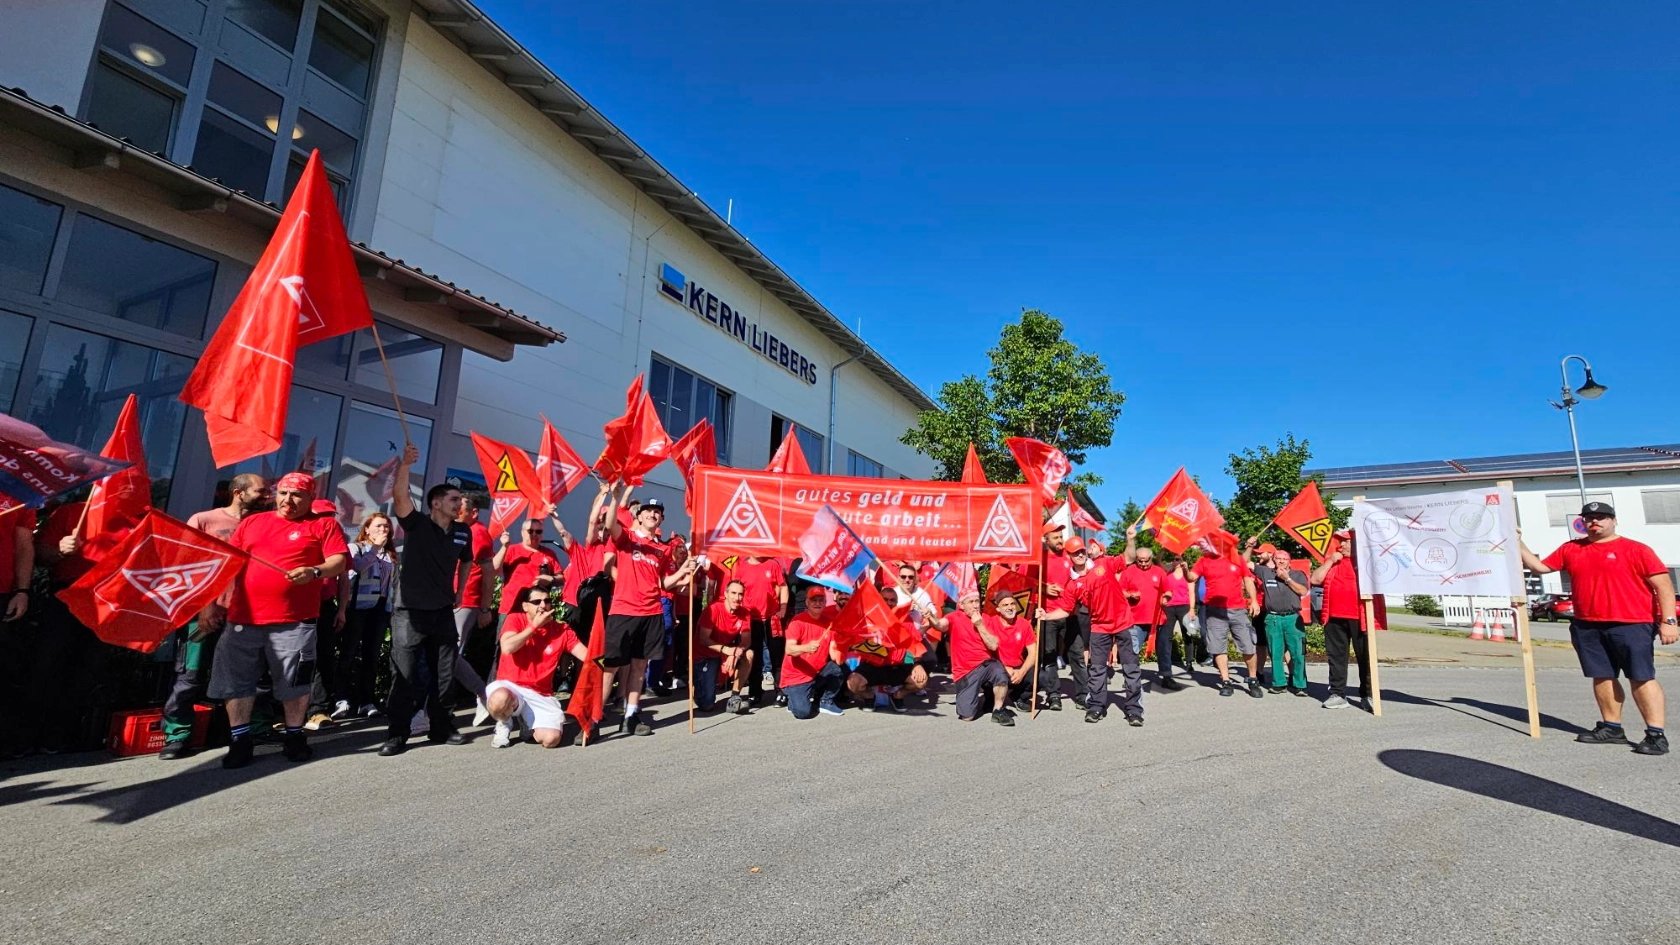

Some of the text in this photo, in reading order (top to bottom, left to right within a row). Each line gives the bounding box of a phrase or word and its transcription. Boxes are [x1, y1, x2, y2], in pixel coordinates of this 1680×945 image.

[689, 281, 817, 385] KERN LIEBERS
[795, 488, 947, 508] gutes geld und
[837, 511, 872, 525] ute
[893, 536, 915, 546] und
[920, 537, 957, 547] leute!
